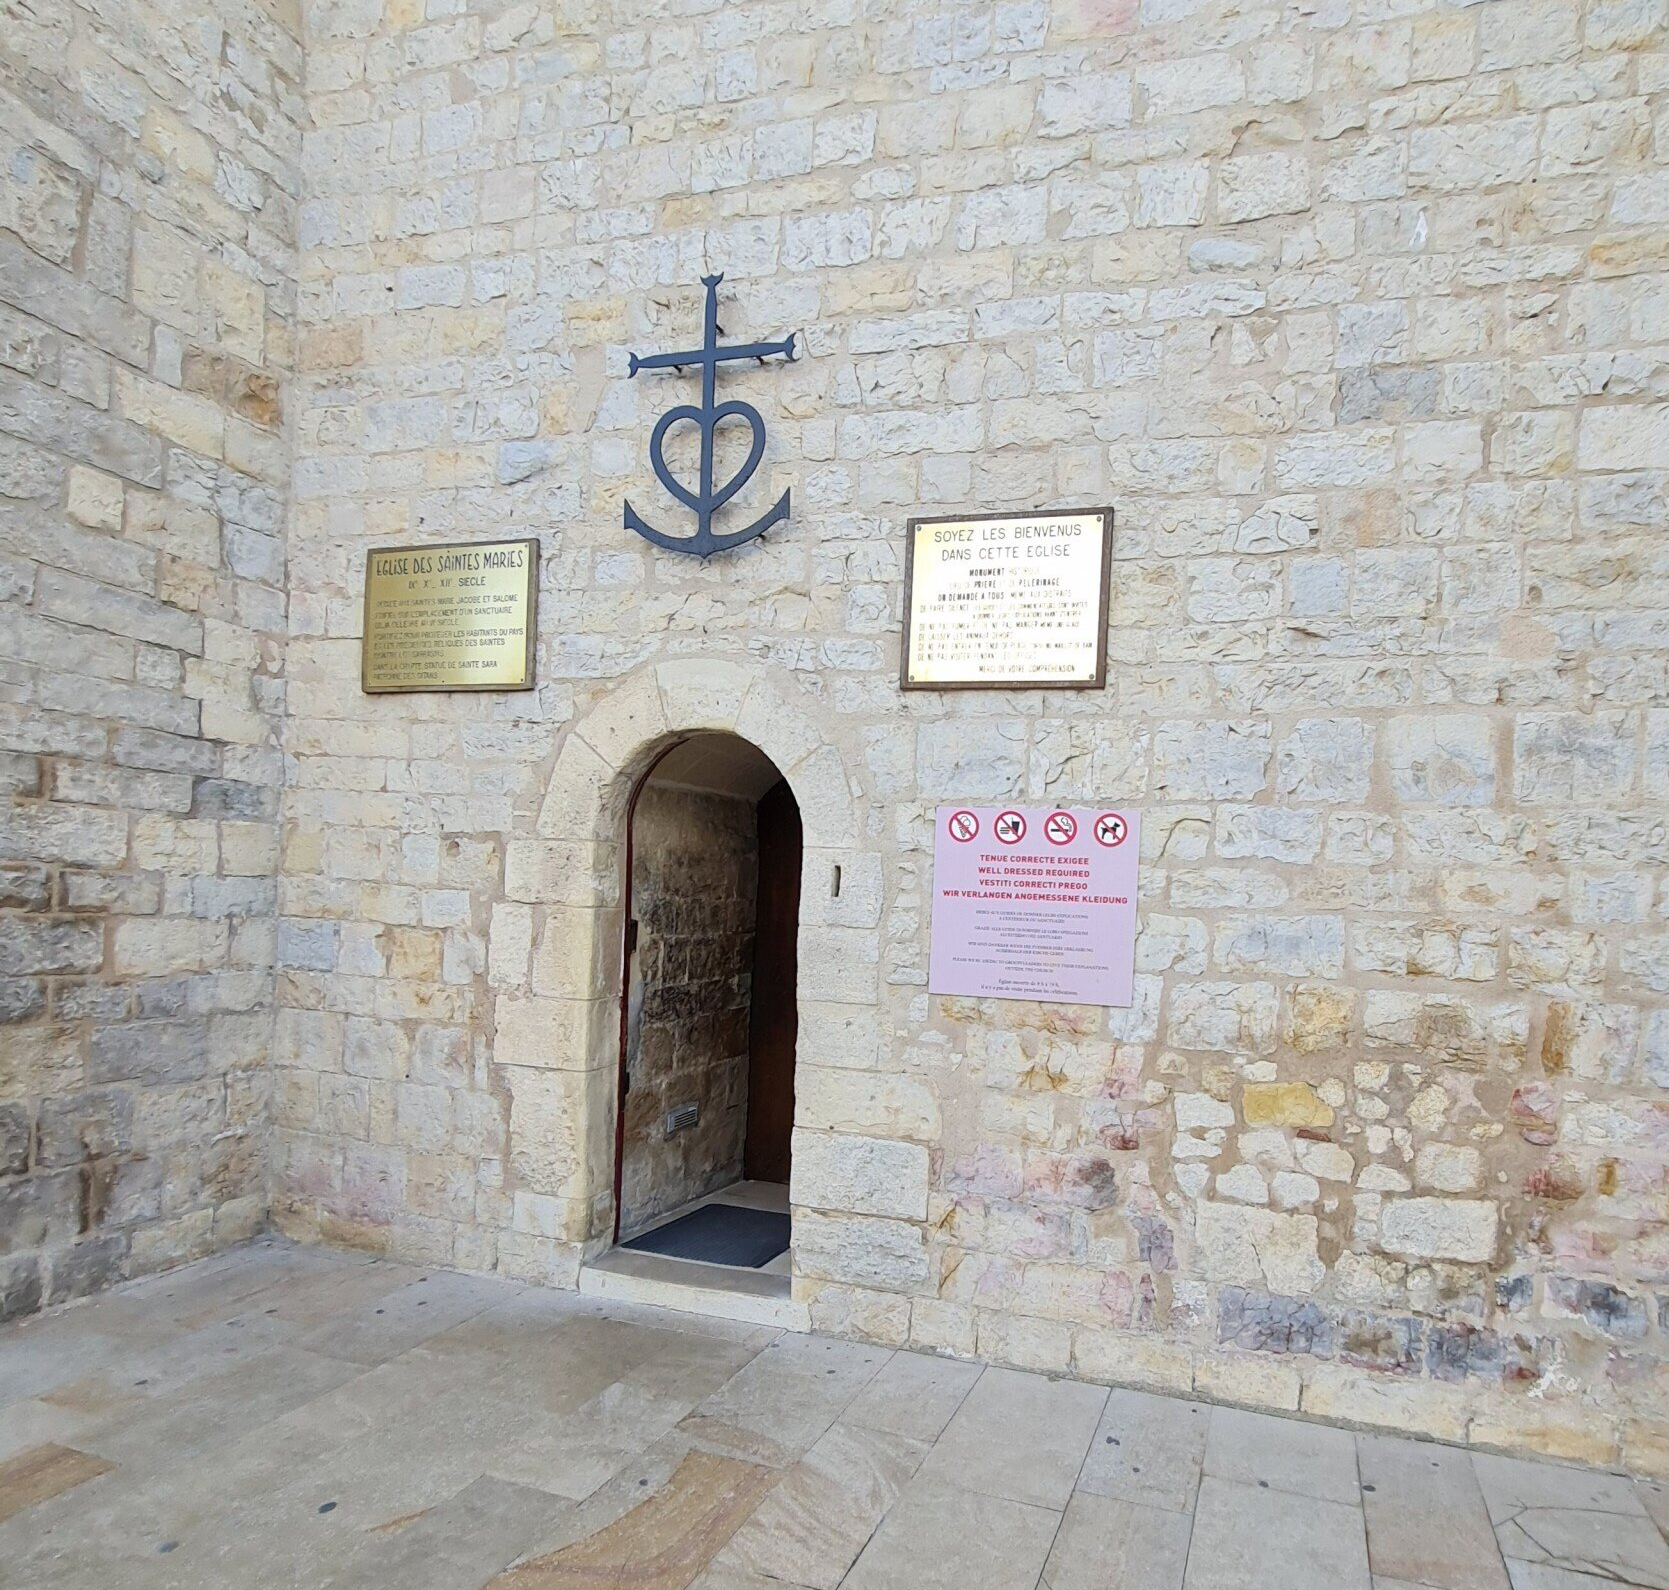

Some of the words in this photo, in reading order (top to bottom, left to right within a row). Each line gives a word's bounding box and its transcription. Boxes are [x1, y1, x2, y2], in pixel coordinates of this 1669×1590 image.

[934, 529, 974, 542] SOYEZ
[982, 527, 1006, 541] LES
[1014, 524, 1082, 539] BIENVENUS
[942, 549, 971, 561] DANS
[979, 546, 1019, 560] CETTE
[1027, 544, 1070, 557] EGLISE
[413, 556, 432, 574] DES
[969, 567, 1005, 577] MONUMENT
[458, 576, 486, 587] SIECLE
[974, 580, 996, 588] PRIERE
[1018, 577, 1060, 587] PELERINAGE
[482, 595, 491, 603] ET
[493, 594, 518, 602] SALOME
[949, 592, 978, 601] DEMANDE
[988, 591, 1005, 599] TOUS
[474, 606, 513, 615] SANCTUAIRE
[453, 629, 465, 638] LES
[498, 628, 507, 636] DU
[508, 627, 523, 636] PAYS
[479, 638, 506, 646] SAINTES
[481, 660, 497, 668] SARA
[980, 854, 1009, 862] TENUE
[1009, 855, 1055, 864] CORRECTE
[1057, 857, 1089, 865] EXIGEE
[978, 867, 1002, 875] WELL
[1004, 867, 1043, 876] DRESSED
[1046, 869, 1090, 878] REQUIRED
[979, 879, 1011, 887] VESTITI
[1013, 880, 1056, 889] CORRECTI
[1058, 882, 1088, 890] PREGO
[943, 889, 959, 897] WIR
[961, 890, 1012, 899] VERLANGEN
[1014, 892, 1080, 902] ANGEMESSENE
[1082, 895, 1128, 904] KLEIDUNG
